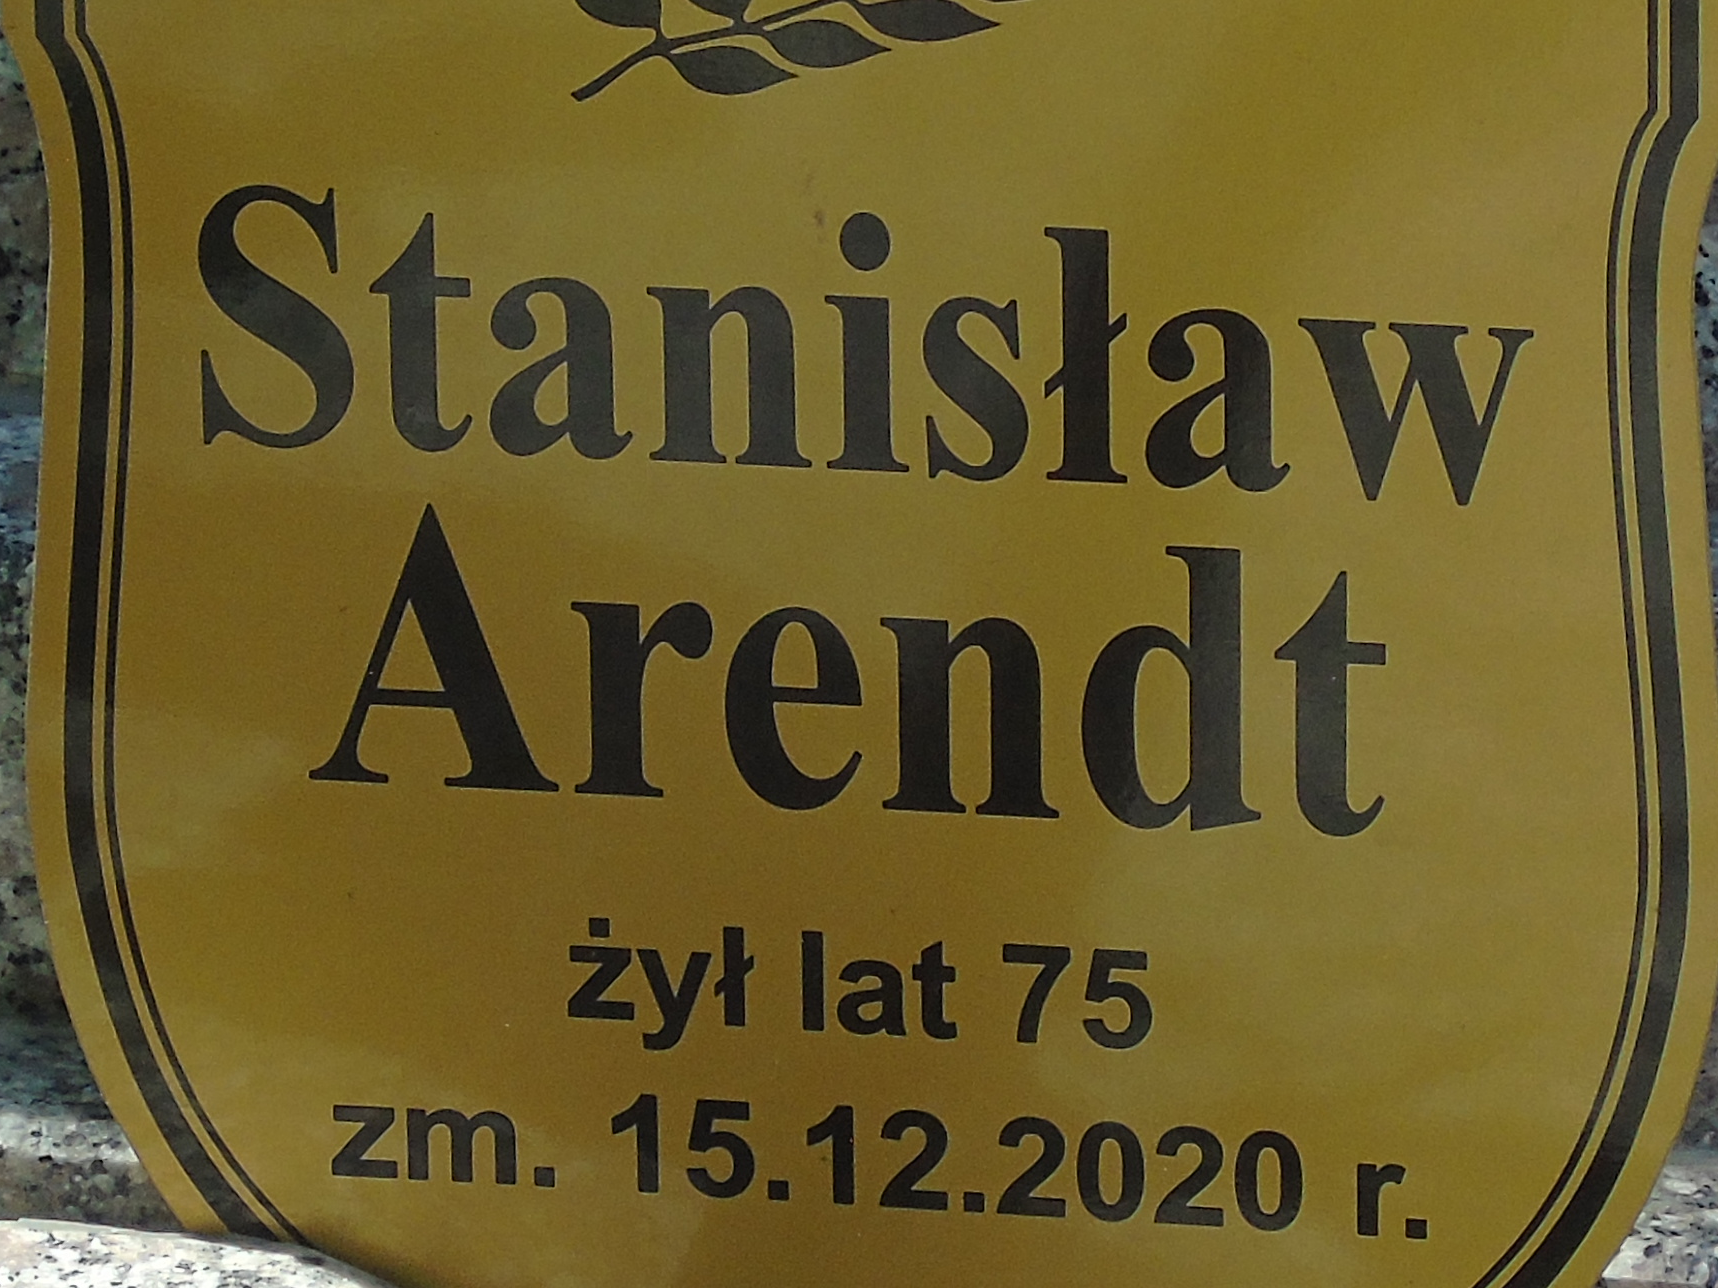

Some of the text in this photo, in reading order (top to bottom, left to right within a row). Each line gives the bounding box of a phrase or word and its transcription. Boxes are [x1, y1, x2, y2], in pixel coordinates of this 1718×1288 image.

[197, 184, 1534, 506] Stanisław
[308, 502, 1387, 837] Arendt
[567, 916, 1153, 1052] żył lat 75
[331, 1092, 1428, 1240] zm. 15.12.2020 r.
